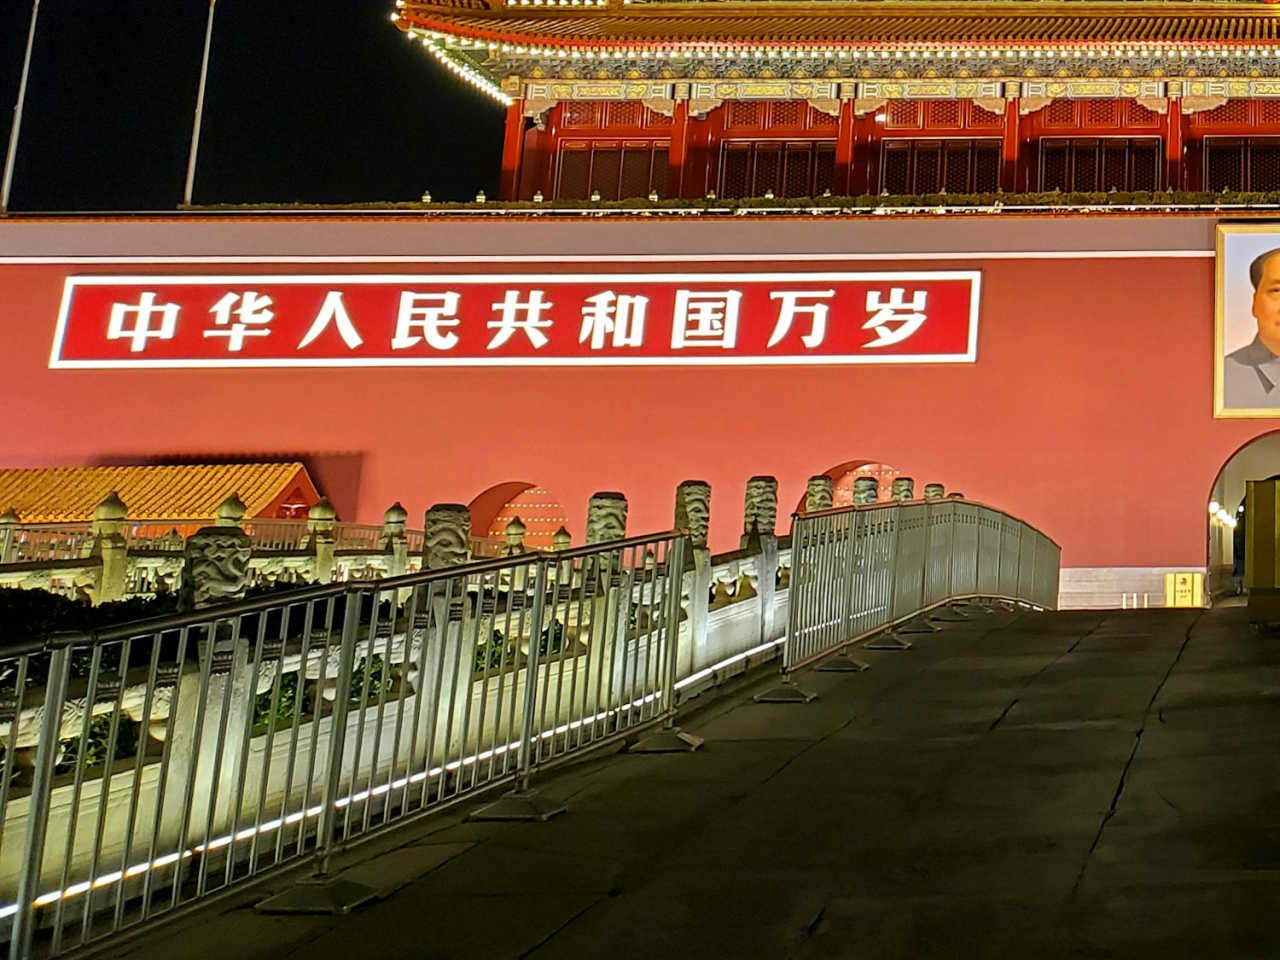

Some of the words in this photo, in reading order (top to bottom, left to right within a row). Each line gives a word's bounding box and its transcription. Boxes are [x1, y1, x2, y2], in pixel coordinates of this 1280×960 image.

[106, 287, 928, 352] 中华人民共和国万岁
